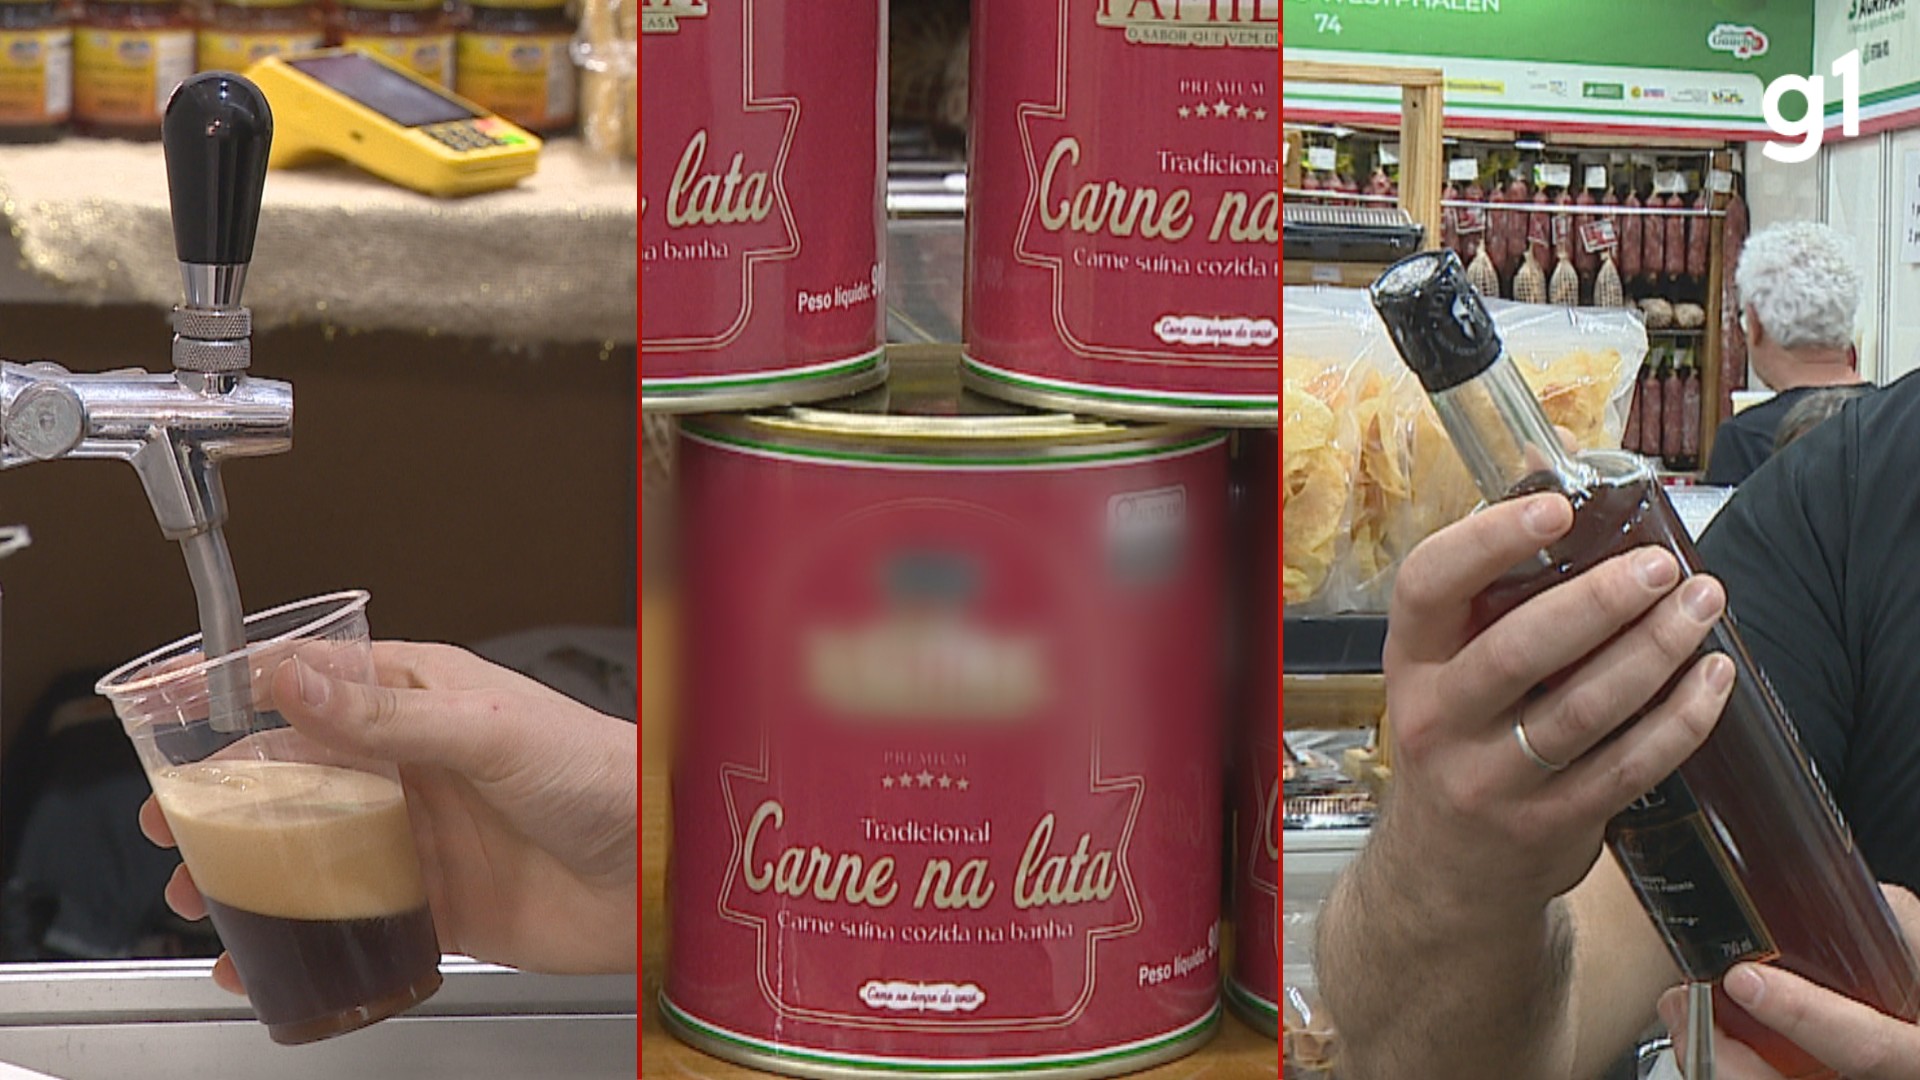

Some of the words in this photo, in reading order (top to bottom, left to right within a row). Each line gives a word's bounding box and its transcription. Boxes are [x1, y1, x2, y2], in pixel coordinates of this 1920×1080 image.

[1314, 13, 1343, 35] 74
[1128, 28, 1137, 39] O
[1143, 28, 1187, 41] SABOR
[1192, 30, 1221, 42] QUE
[1228, 31, 1259, 44] VEM
[1179, 80, 1266, 96] PREMIUM
[667, 129, 773, 227] lata
[1039, 136, 1194, 241] Carne
[1208, 191, 1279, 243] na
[664, 239, 729, 259] banha
[1073, 248, 1129, 271] Carne
[1135, 254, 1190, 275] suína
[1196, 256, 1268, 278] cozida
[798, 291, 832, 314] Peso
[884, 752, 967, 767] PREMIUM
[861, 818, 990, 844] Tradicional
[743, 800, 898, 908] Carne
[913, 858, 995, 910] na
[1013, 812, 1117, 909] lata
[777, 908, 834, 933] Carne
[841, 919, 894, 940] suína
[901, 924, 971, 943] cozida
[977, 927, 1004, 944] na
[1010, 919, 1074, 941] banha
[1139, 964, 1172, 987] Peso
